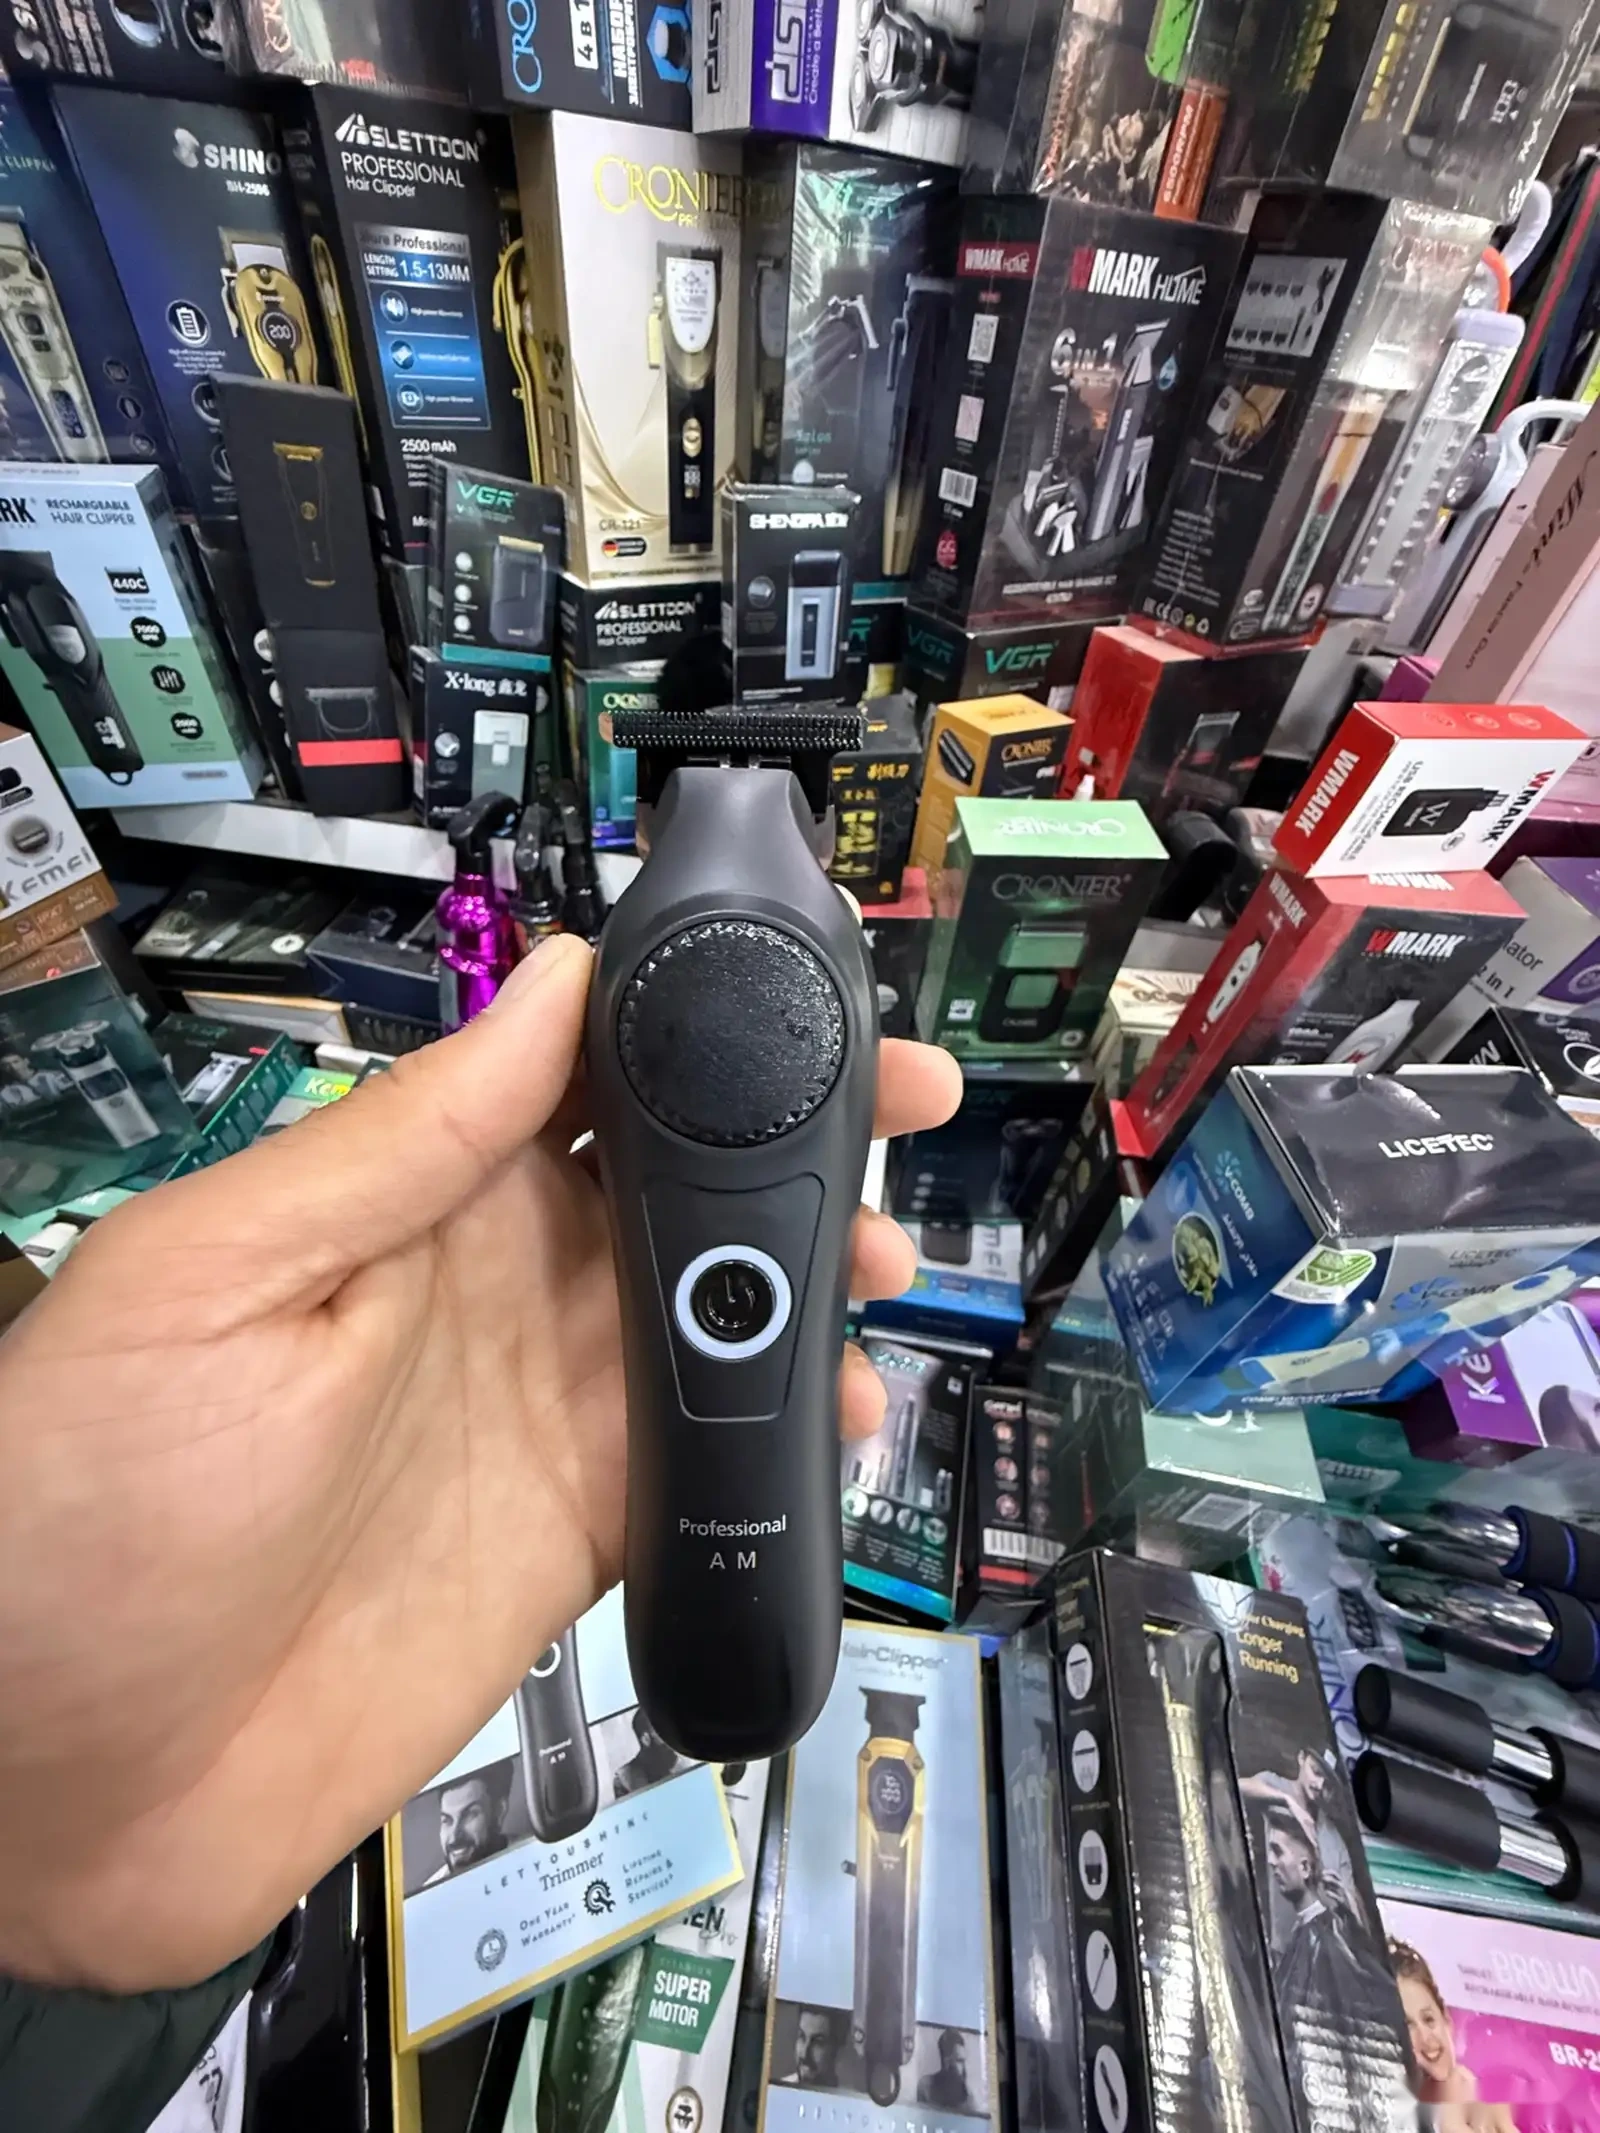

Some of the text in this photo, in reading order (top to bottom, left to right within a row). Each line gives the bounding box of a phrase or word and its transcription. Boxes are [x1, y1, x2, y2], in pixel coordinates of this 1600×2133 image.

[577, 45, 593, 61] 4
[341, 151, 465, 188] PROFESSIONAL
[345, 175, 416, 198] Hair Clipper
[393, 232, 467, 252] Professional
[364, 252, 396, 266] LENGTH
[399, 259, 470, 282] 1.5-13MM
[400, 439, 430, 453] 2500
[46, 499, 131, 511] RECHARGEABLE
[456, 480, 516, 508] VGR
[0, 497, 36, 523] RK
[50, 511, 137, 525] HAIR CLIPPER
[113, 578, 147, 590] 440C
[1365, 929, 1466, 958] WMARK
[1377, 1131, 1492, 1159] LICETEC
[678, 1513, 788, 1538] Professional
[709, 1550, 757, 1570] A M
[1235, 1631, 1283, 1653] Longer
[1239, 1649, 1299, 1684] Running
[538, 1852, 606, 1893] Trimmer
[653, 1969, 712, 2005] SUPER
[648, 1998, 700, 2028] MOTOR
